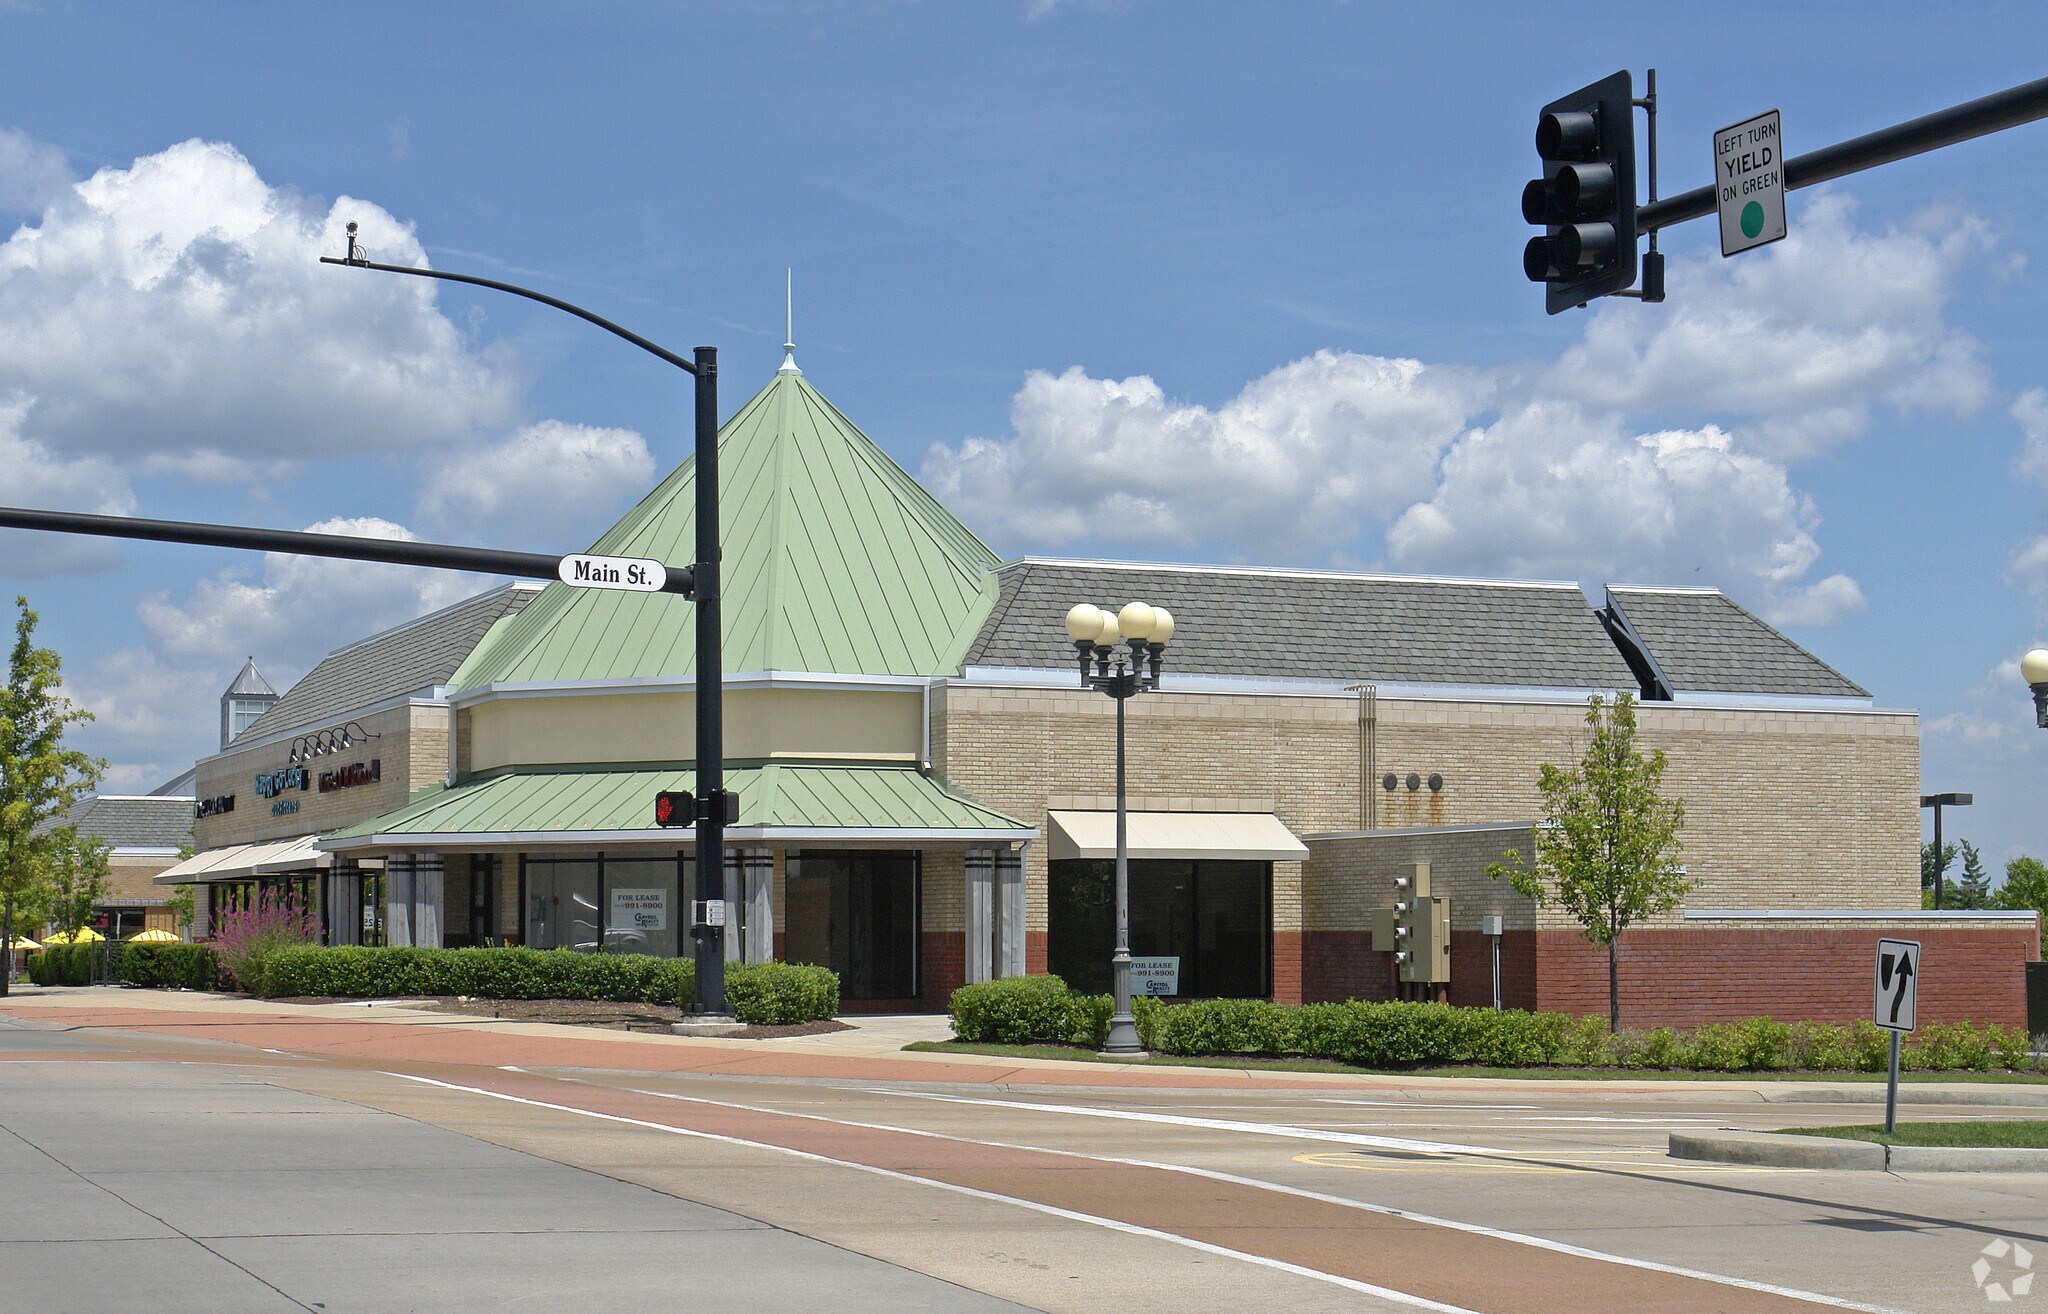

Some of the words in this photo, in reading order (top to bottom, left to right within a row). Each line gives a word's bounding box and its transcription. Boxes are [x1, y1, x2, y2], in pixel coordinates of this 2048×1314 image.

[1718, 133, 1743, 156] LEFT
[1748, 121, 1776, 144] TURN
[1725, 146, 1772, 178] YIELD
[1722, 184, 1737, 202] ON
[1742, 170, 1778, 195] GREEN
[574, 560, 620, 583] Main
[627, 564, 652, 586] St.
[1146, 980, 1169, 989] CAPITOL
